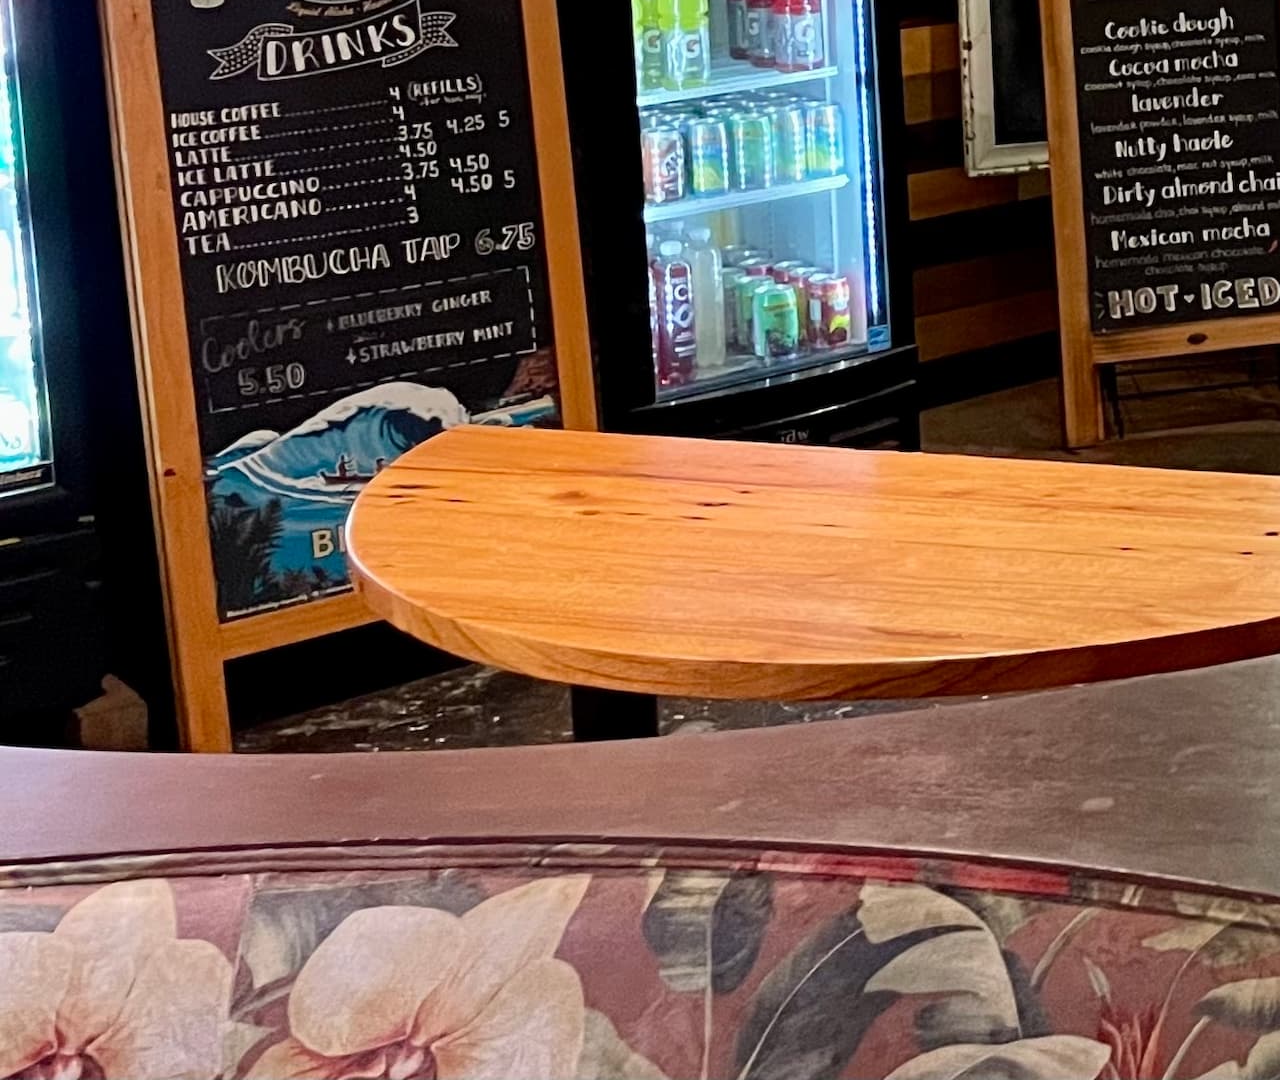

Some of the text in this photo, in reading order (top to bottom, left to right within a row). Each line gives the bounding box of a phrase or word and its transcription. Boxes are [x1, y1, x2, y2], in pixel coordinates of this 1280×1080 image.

[265, 14, 416, 76] DRINKS
[1105, 7, 1234, 40] Cookie dough
[1109, 50, 1238, 77] Cocoa mocha
[171, 108, 216, 129] HOUSE
[221, 102, 281, 124] COFFEE
[389, 86, 400, 101] 4
[172, 106, 404, 148] ICE COFFEE 4
[174, 111, 510, 167] LATTE 3.75 4.25 5
[1115, 130, 1233, 161] Nutty haole
[178, 141, 437, 187] ICE LATTE 4.50
[181, 154, 489, 208] CAPPUCCINO 3.75 4.50
[182, 170, 515, 234] AMERICANO 4 4.50 5
[1103, 182, 1155, 207] Dirty
[1161, 172, 1233, 199] almond
[184, 206, 419, 256] TEA 3
[1111, 217, 1270, 251] Mexican mocha
[216, 222, 536, 294] KOMBUCHA TAP 6.75
[1107, 277, 1280, 319] HOT ICED
[201, 316, 306, 373] Coolers
[432, 290, 492, 314] GINGER
[238, 321, 514, 396] 5.50 STRAWBERRY MINT
